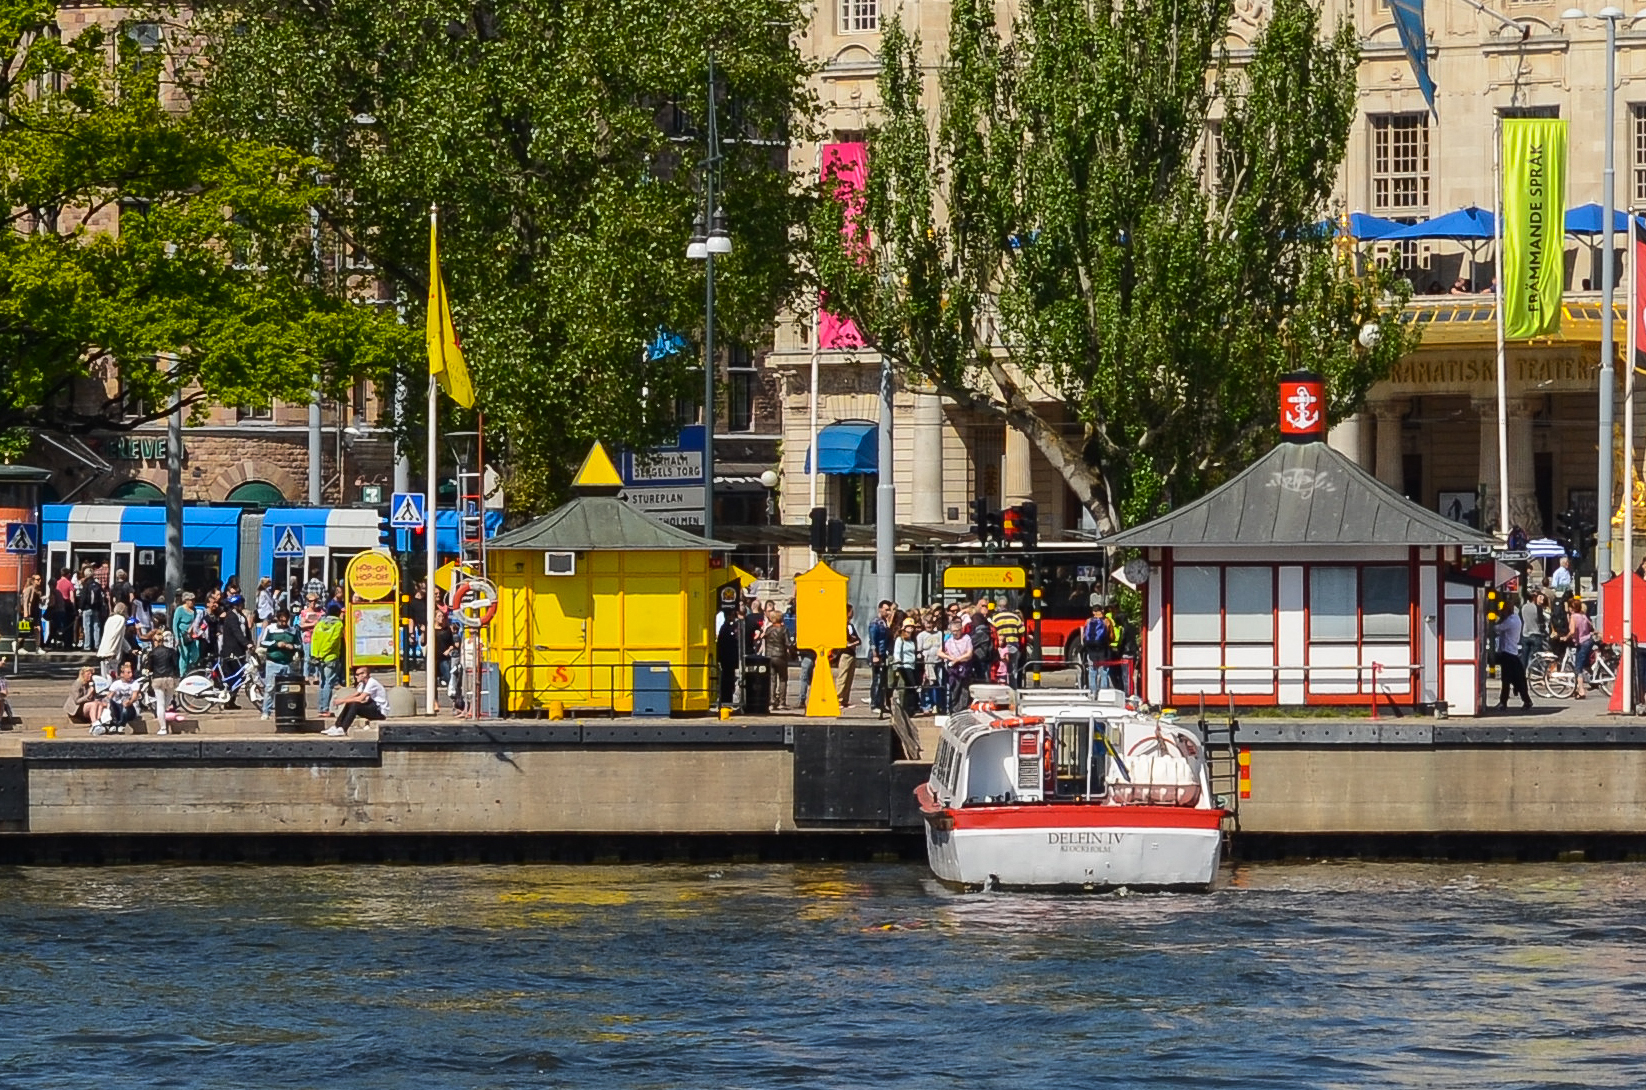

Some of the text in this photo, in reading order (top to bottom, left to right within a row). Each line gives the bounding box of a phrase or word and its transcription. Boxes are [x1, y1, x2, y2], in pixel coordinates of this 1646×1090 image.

[1525, 143, 1543, 312] FRÄMMANDE SPRÅK
[677, 466, 700, 477] TORG
[632, 494, 683, 504] STUREPLAN
[1048, 832, 1125, 844] DELFIN IV
